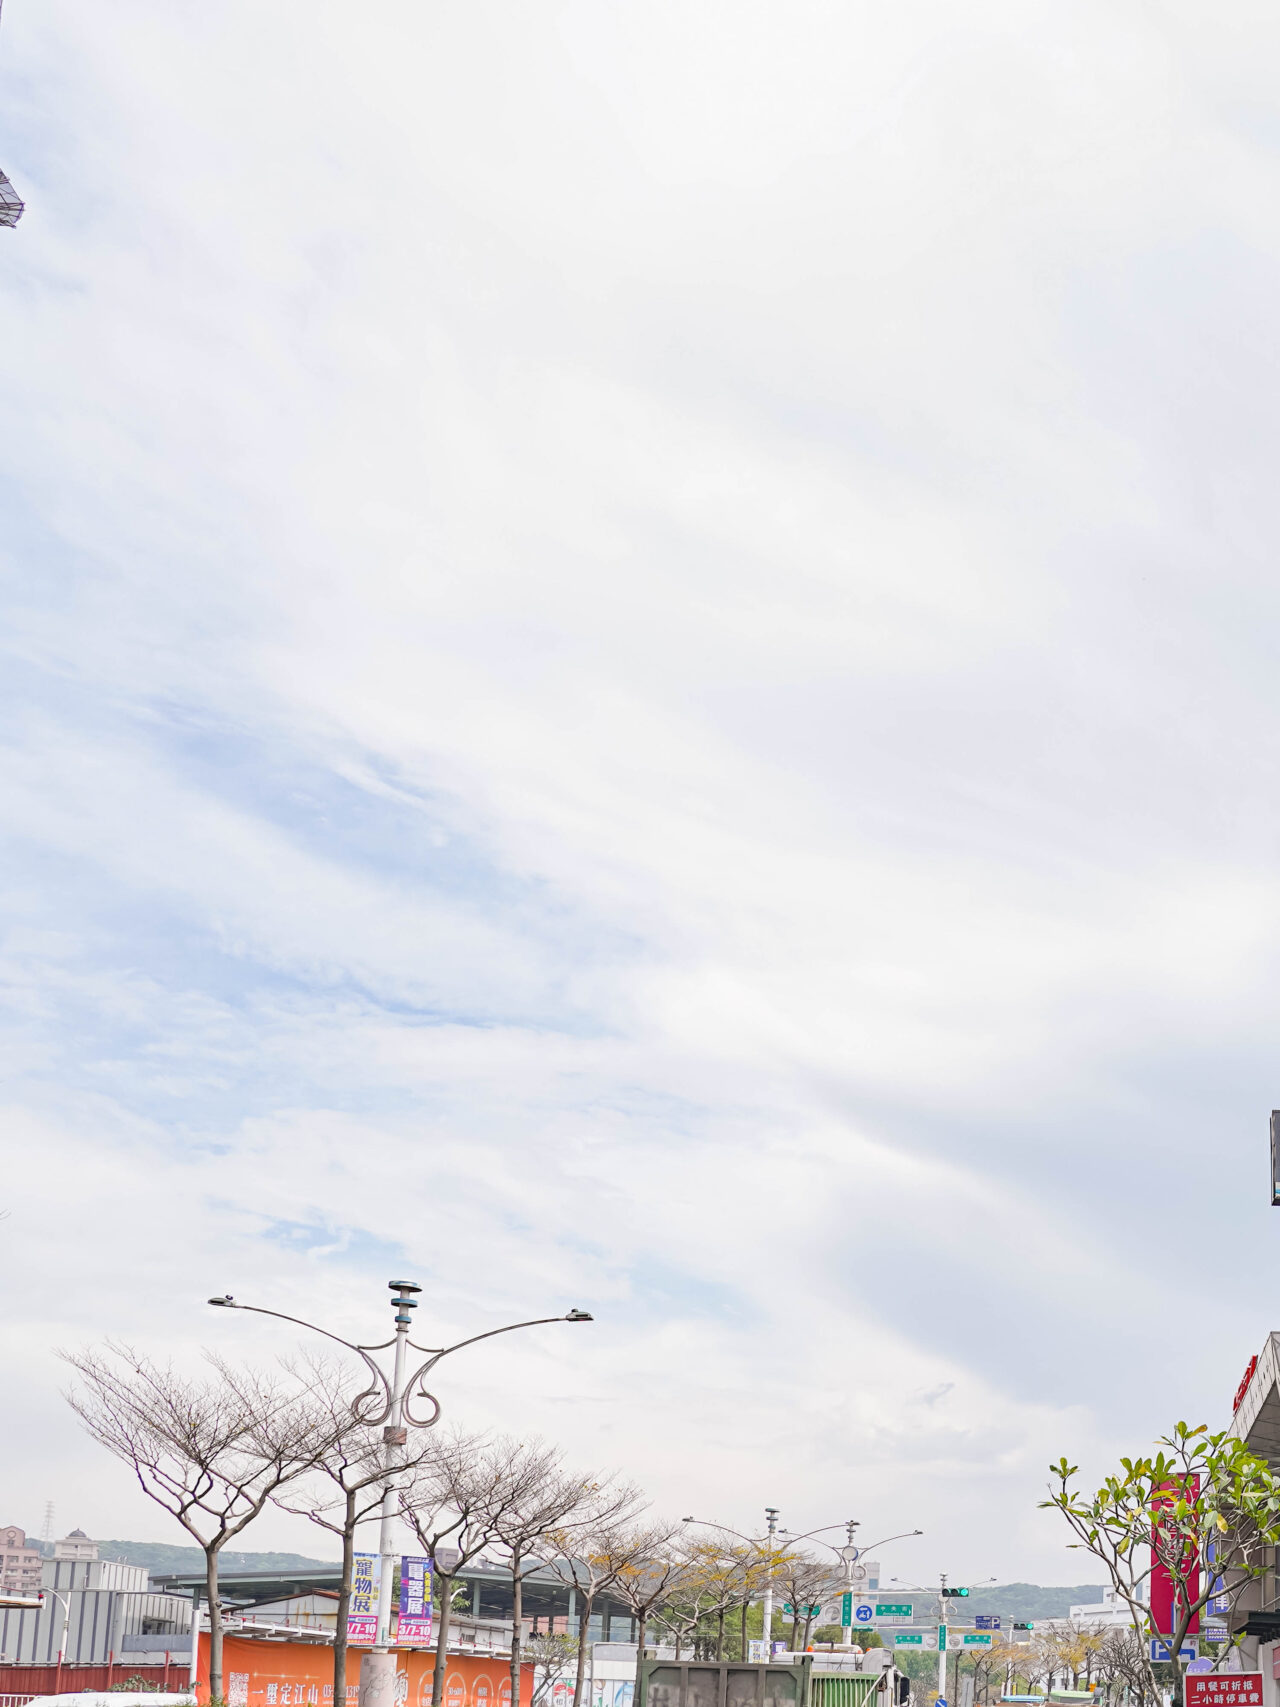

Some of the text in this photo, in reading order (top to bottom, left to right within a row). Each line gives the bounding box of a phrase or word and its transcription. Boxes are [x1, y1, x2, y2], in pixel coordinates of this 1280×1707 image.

[353, 1559, 372, 1613] 寵物展
[407, 1563, 424, 1615] 電器展
[398, 1625, 431, 1636] 3/7-10
[252, 1683, 319, 1705] 一璽定江山
[1196, 1681, 1253, 1692] 用餐可折抵
[1191, 1693, 1259, 1704] 二小時停車費
